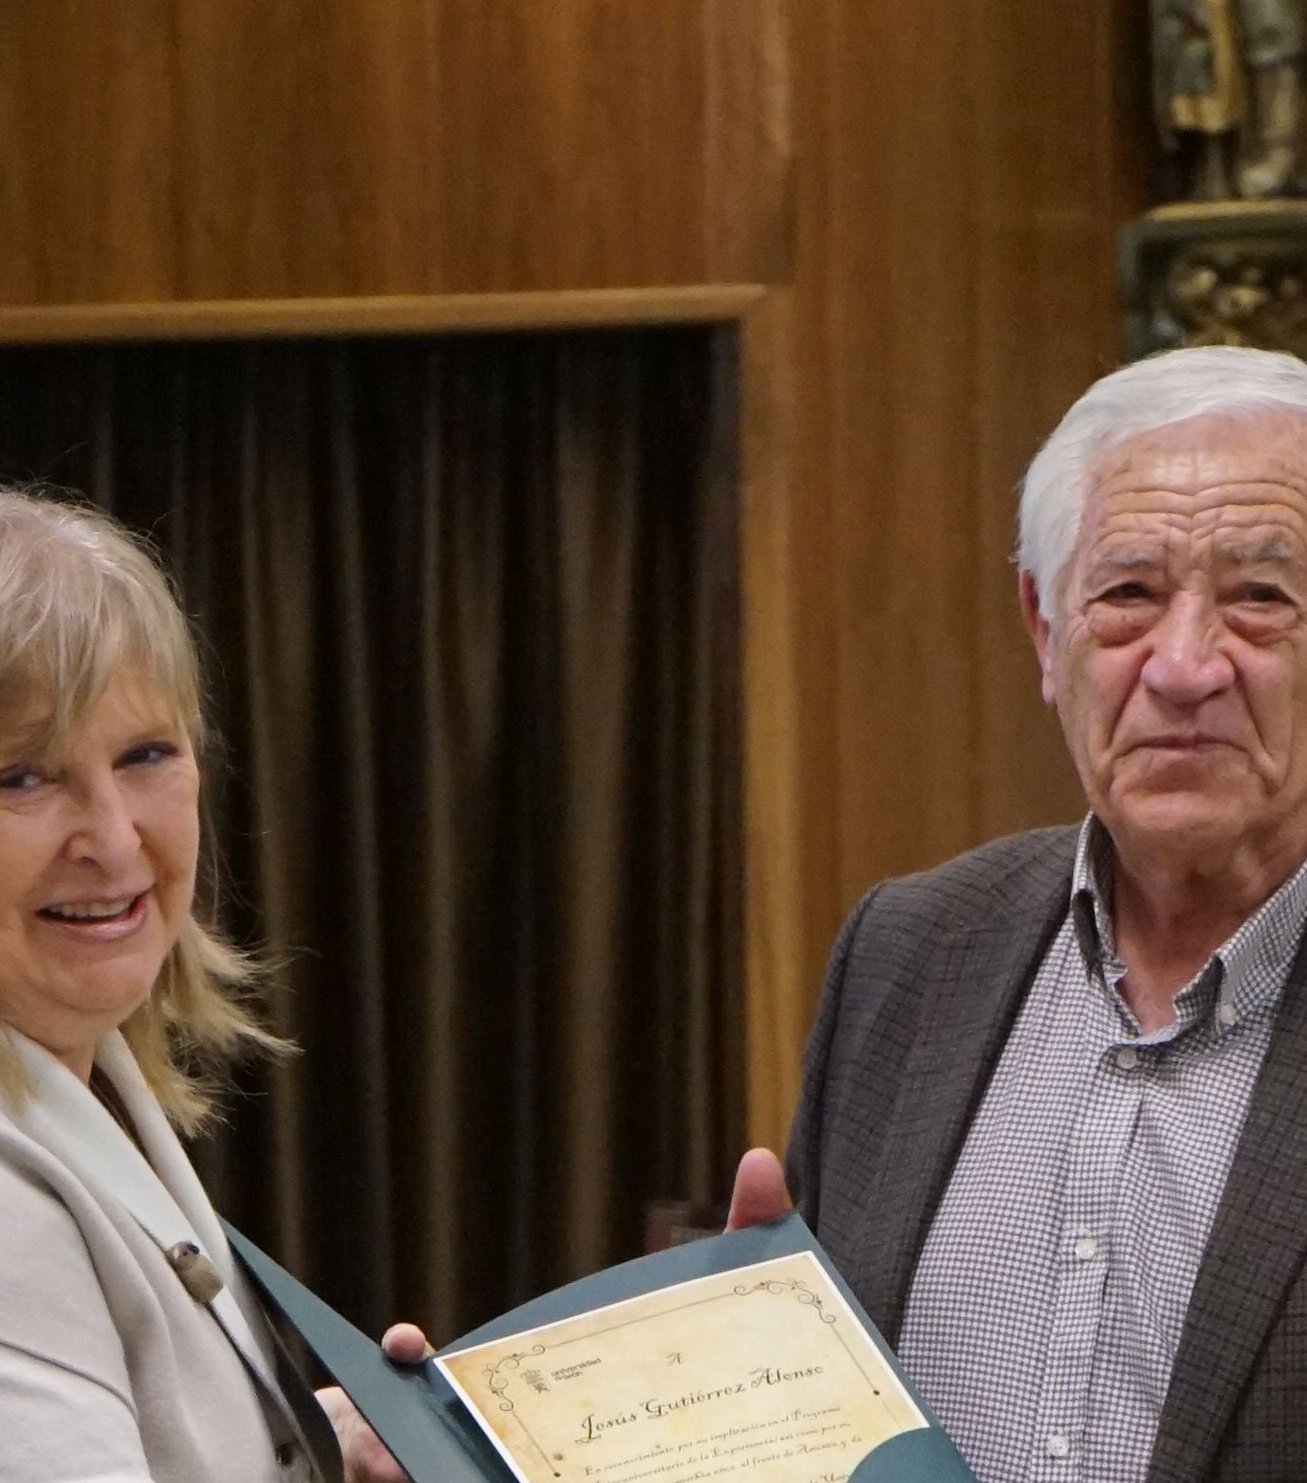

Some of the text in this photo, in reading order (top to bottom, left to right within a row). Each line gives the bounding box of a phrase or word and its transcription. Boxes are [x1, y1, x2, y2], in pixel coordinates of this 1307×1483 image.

[550, 1357, 602, 1375] universidad
[575, 1365, 825, 1444] Jesús Gutiérrez Alonso
